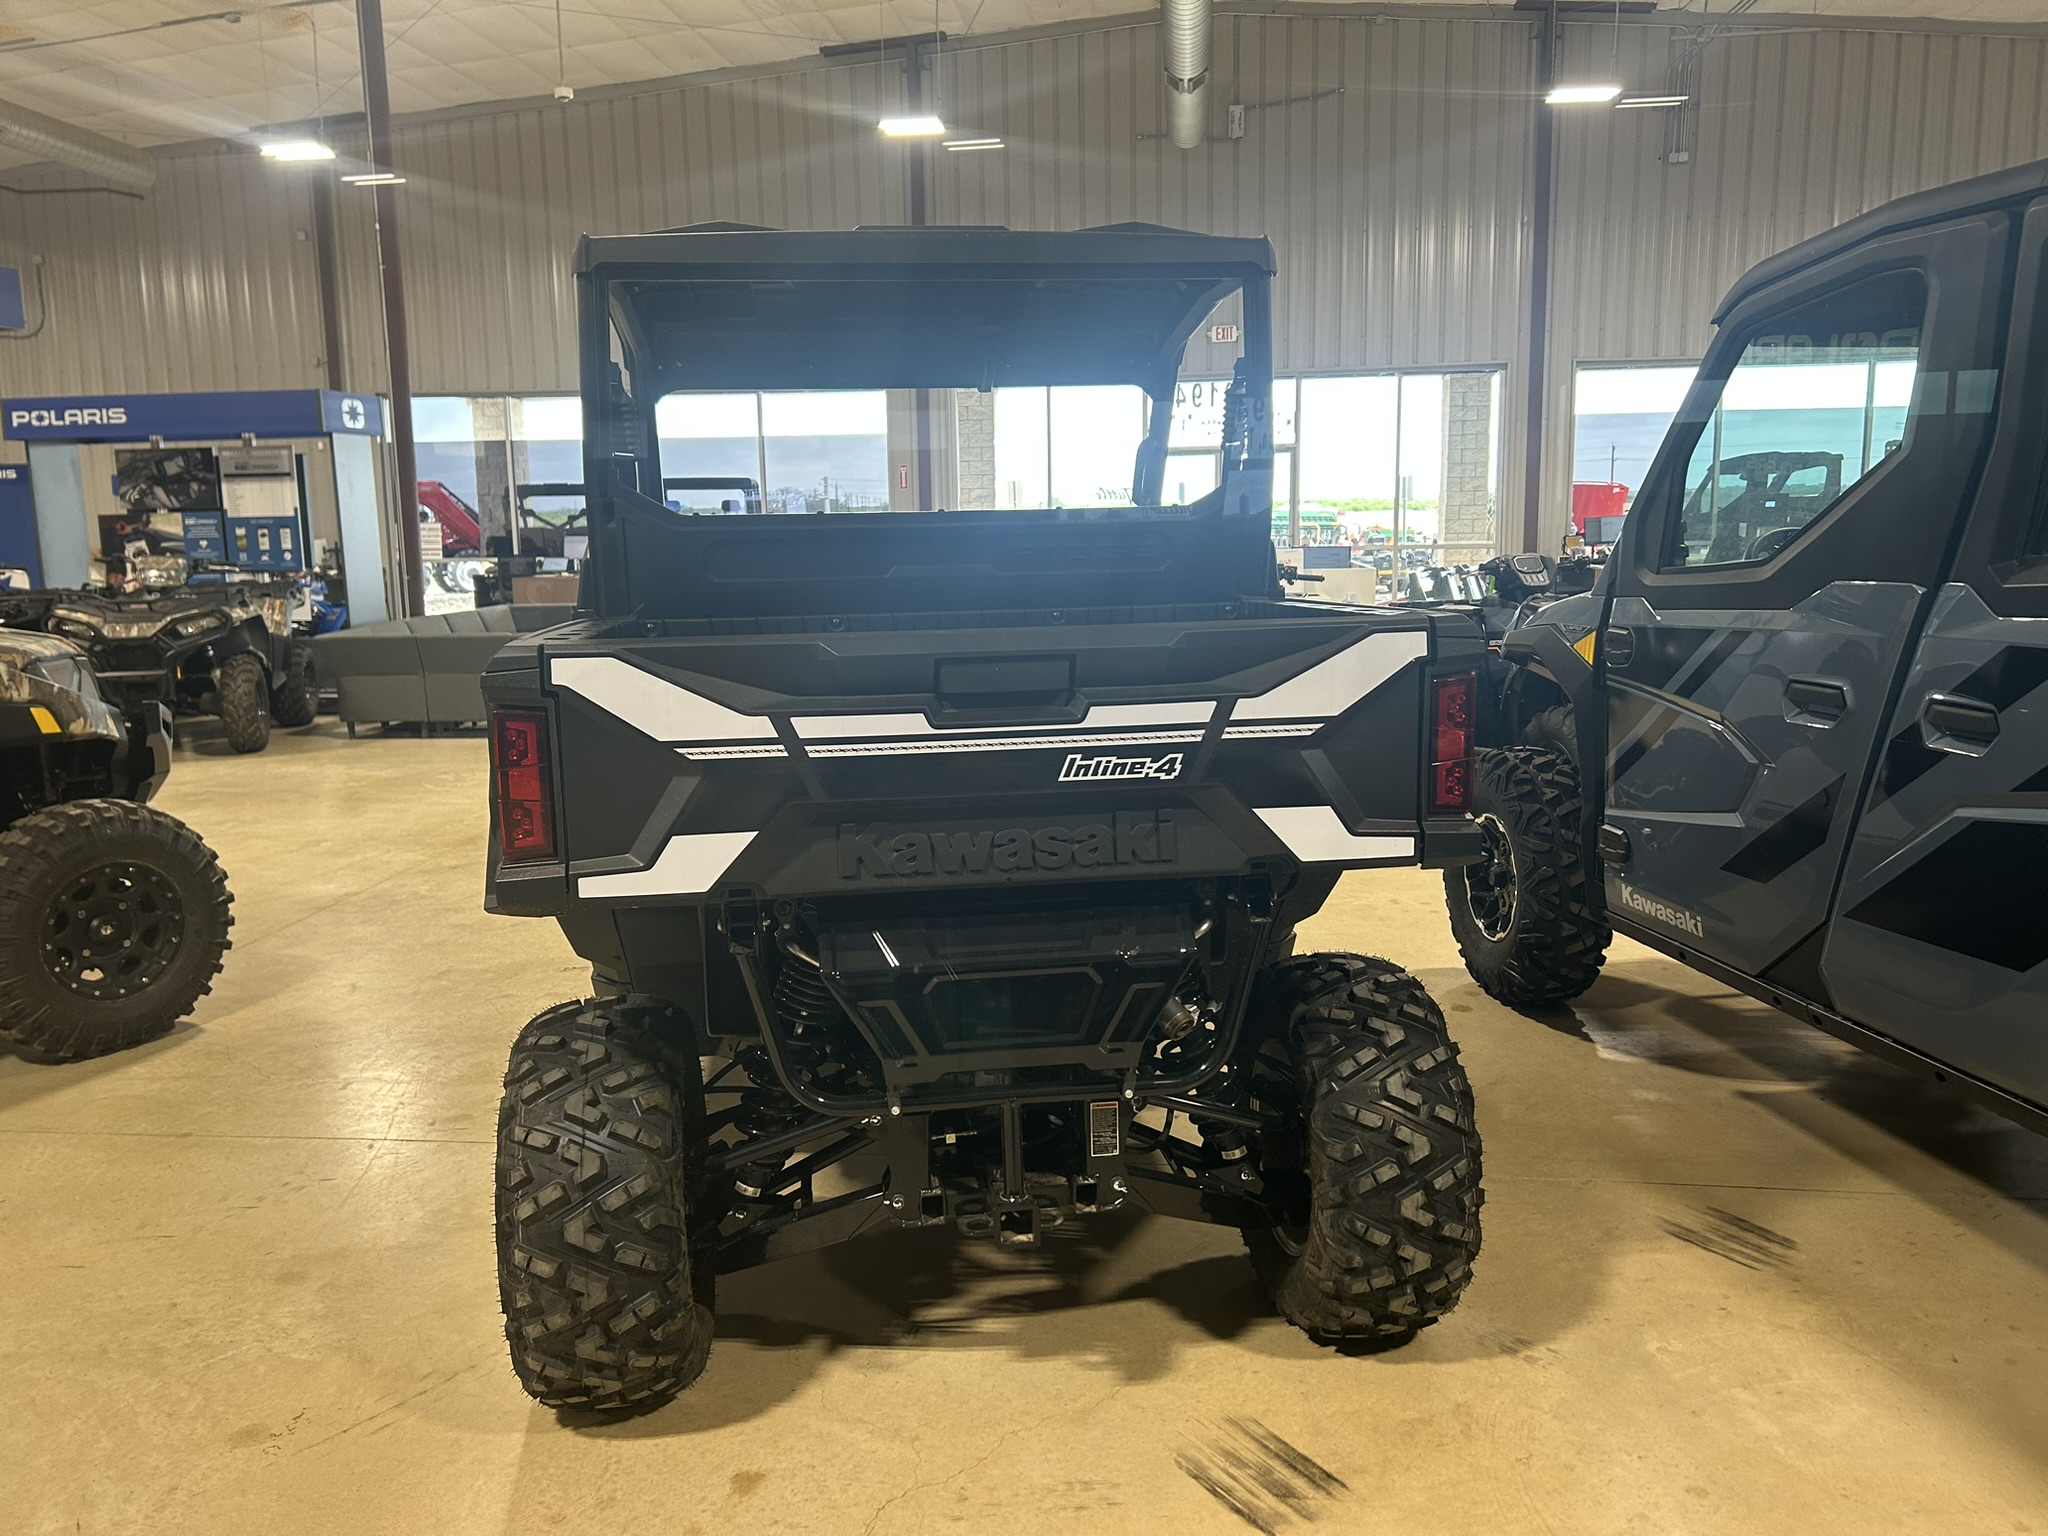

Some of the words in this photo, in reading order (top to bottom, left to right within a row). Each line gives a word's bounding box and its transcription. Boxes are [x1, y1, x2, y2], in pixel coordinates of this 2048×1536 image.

[1215, 326, 1234, 341] EXIT
[11, 407, 128, 428] POLARIS
[1058, 753, 1184, 781] Inline-4
[838, 808, 1178, 880] Kawasaki
[1621, 883, 1704, 938] Kawasaki
